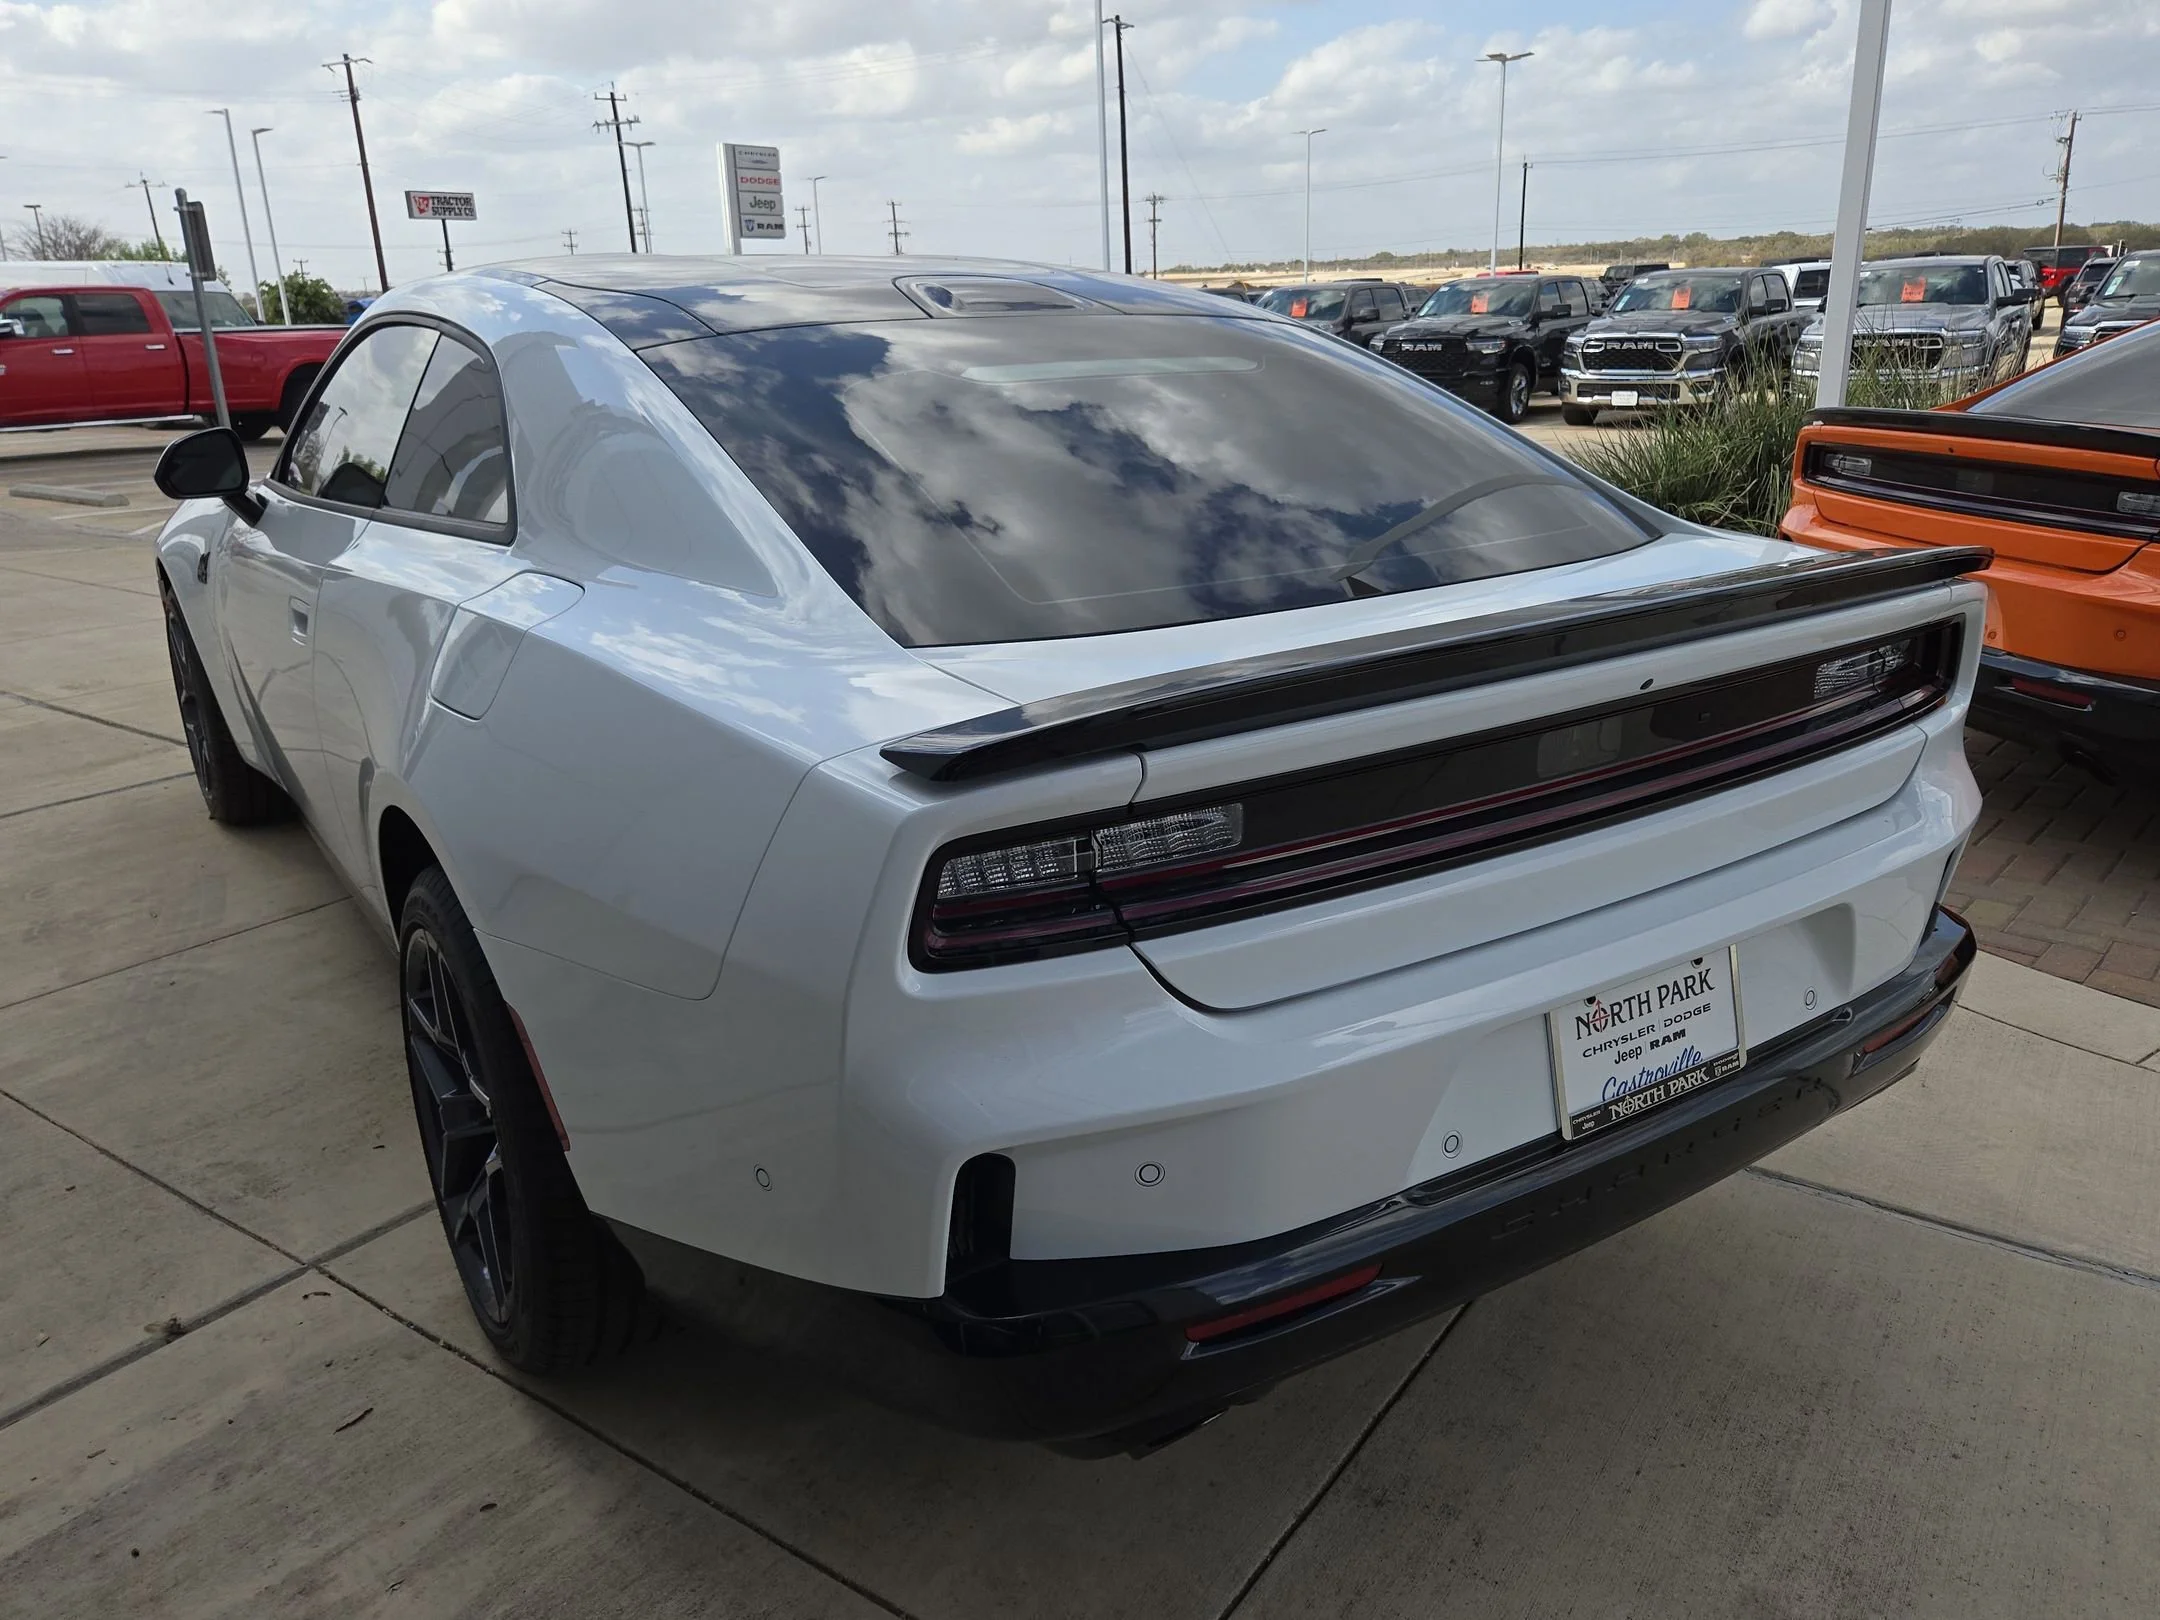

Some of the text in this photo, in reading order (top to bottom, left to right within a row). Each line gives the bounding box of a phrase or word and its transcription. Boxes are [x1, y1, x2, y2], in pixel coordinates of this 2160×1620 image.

[740, 176, 781, 186] DODGE
[431, 196, 472, 206] TRACTOR
[749, 196, 776, 212] Jeep
[432, 207, 463, 217] SUPPLY
[757, 223, 784, 231] RAM
[1401, 343, 1442, 352] RAM
[1606, 342, 1654, 350] RAM
[1575, 968, 1716, 1041] NORTH PARK
[1582, 1002, 1711, 1058] CHRYSLER DODGE
[1614, 1028, 1687, 1065] Jeep RAM
[1721, 1060, 1740, 1072] RAM
[1602, 1045, 1704, 1102] Castroville
[1609, 1066, 1711, 1120] NORTH PARK
[1581, 1120, 1595, 1130] Jeep
